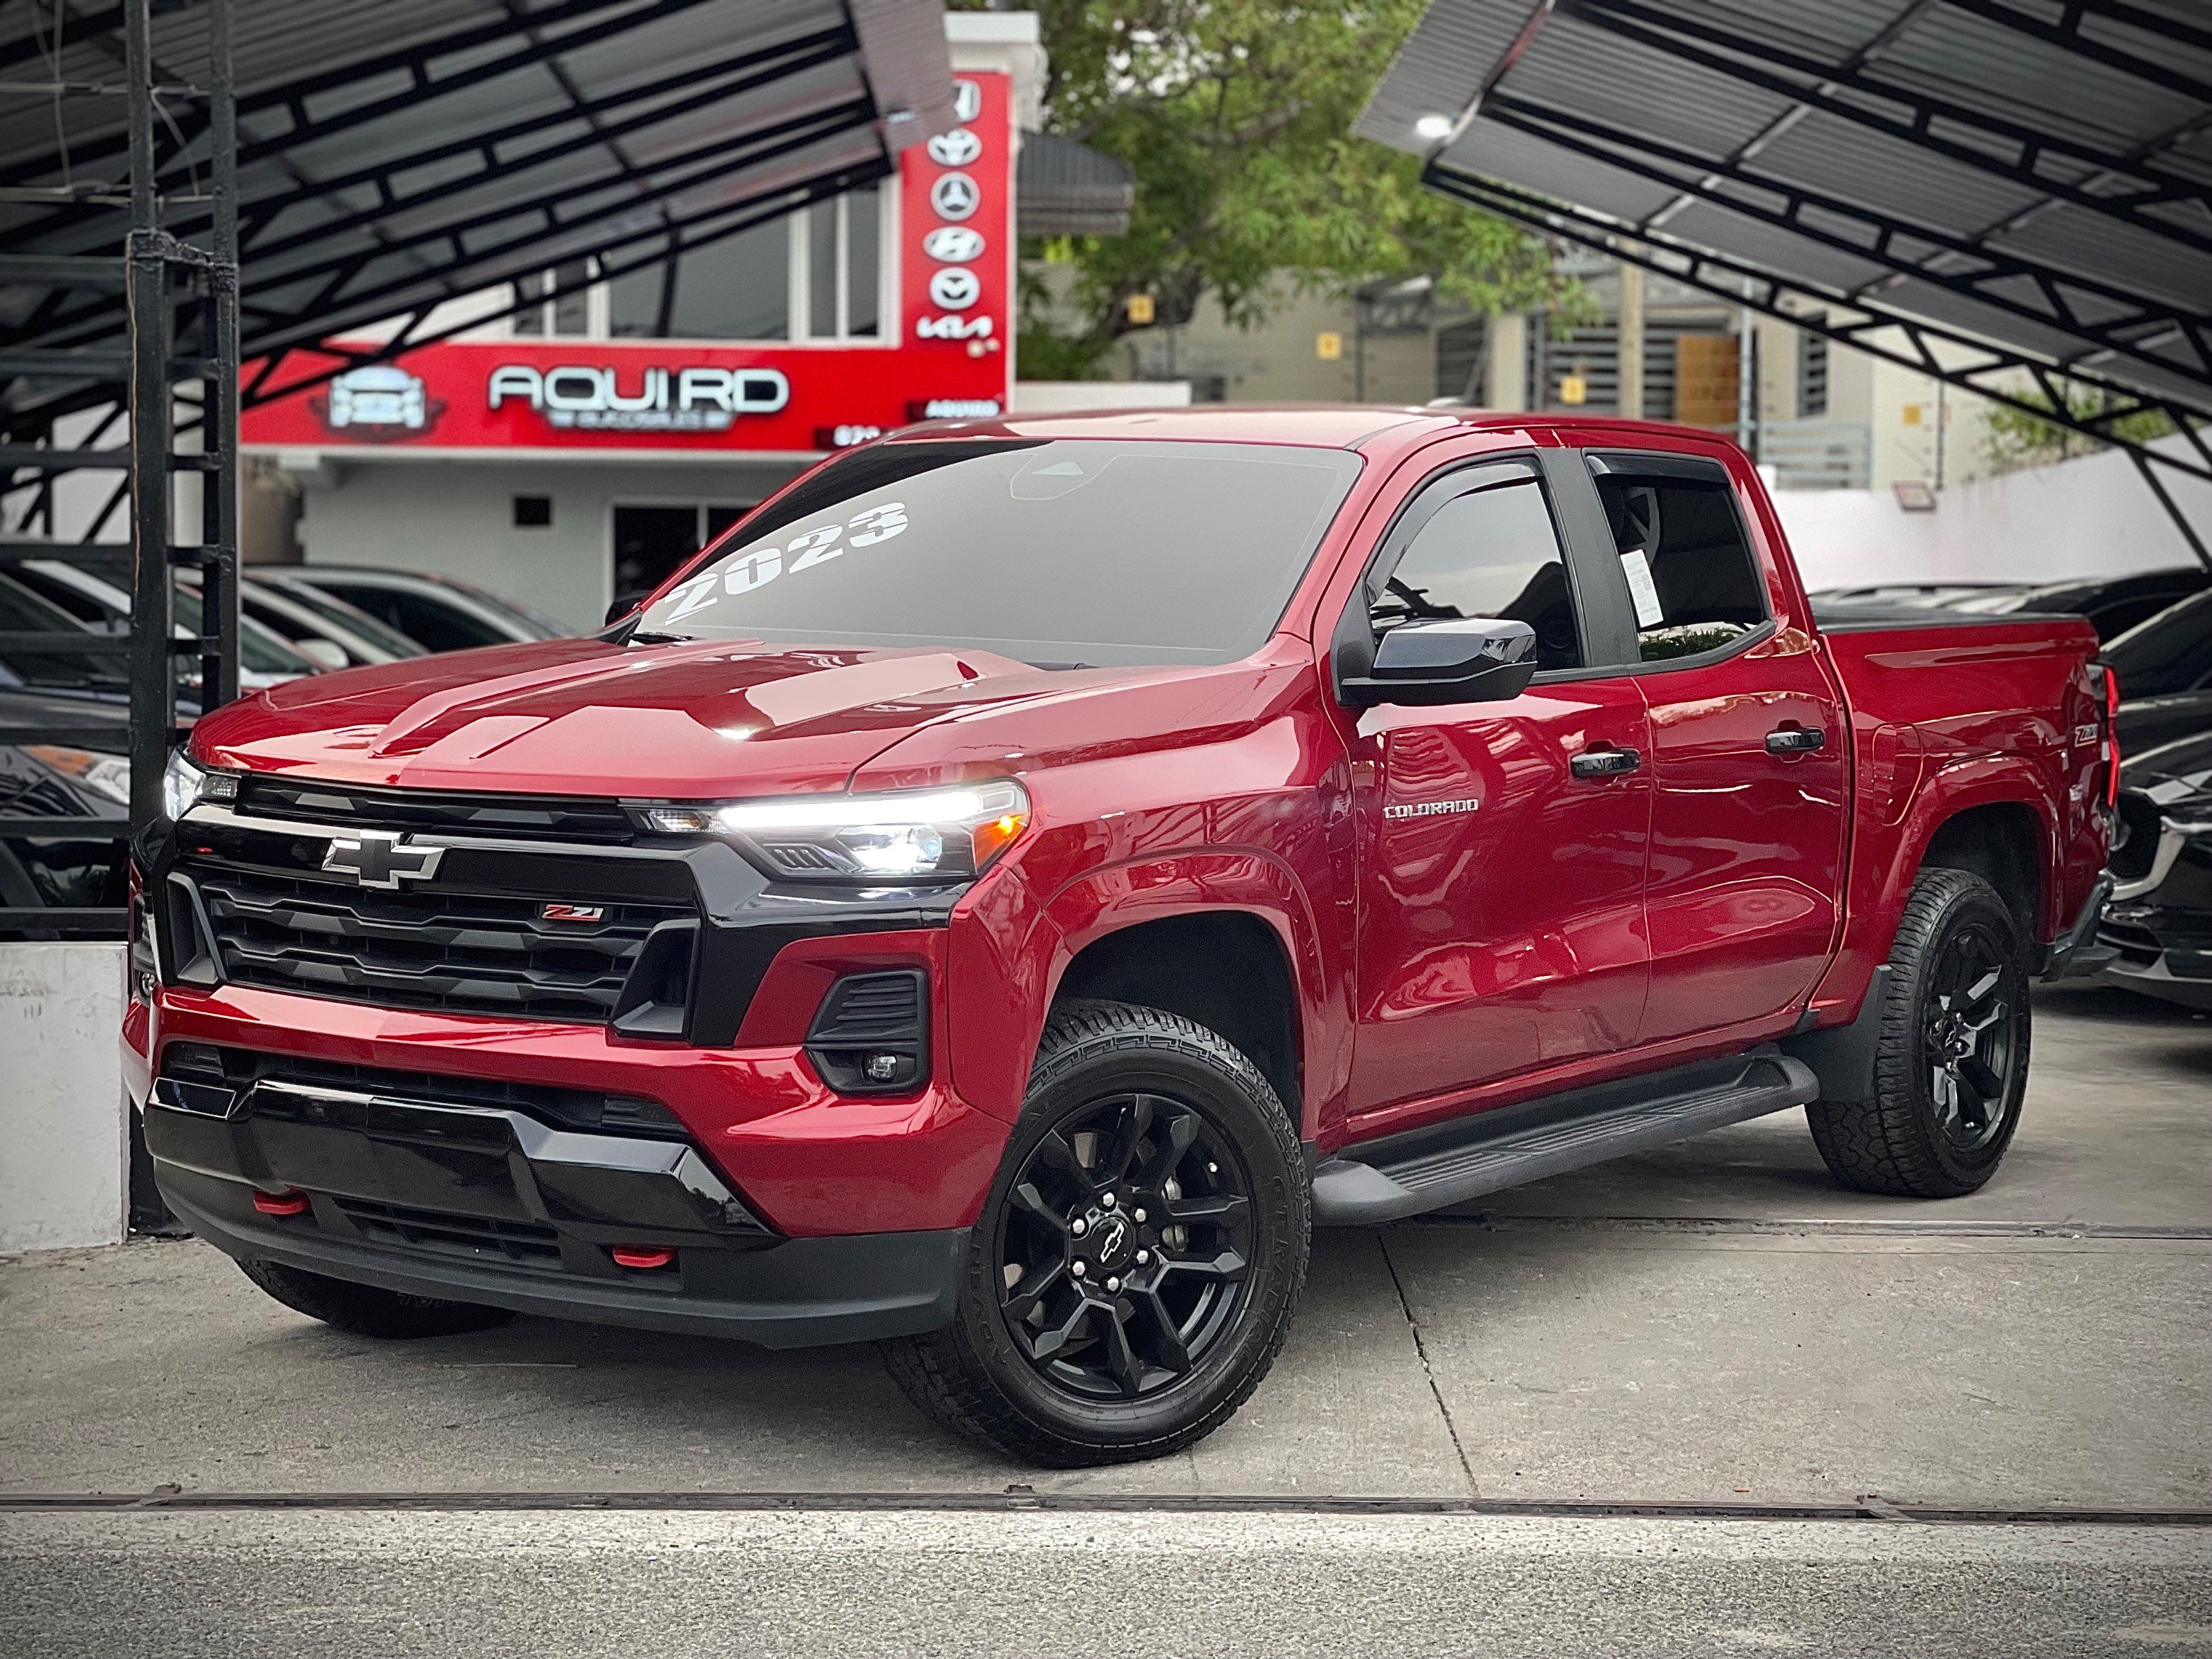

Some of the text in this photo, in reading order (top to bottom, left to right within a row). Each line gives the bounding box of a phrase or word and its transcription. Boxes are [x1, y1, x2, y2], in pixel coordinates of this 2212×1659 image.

[664, 502, 909, 626] 2023
[2074, 722, 2099, 748] Z71
[1383, 799, 1479, 819] COLORADO
[542, 903, 604, 922] Z71
